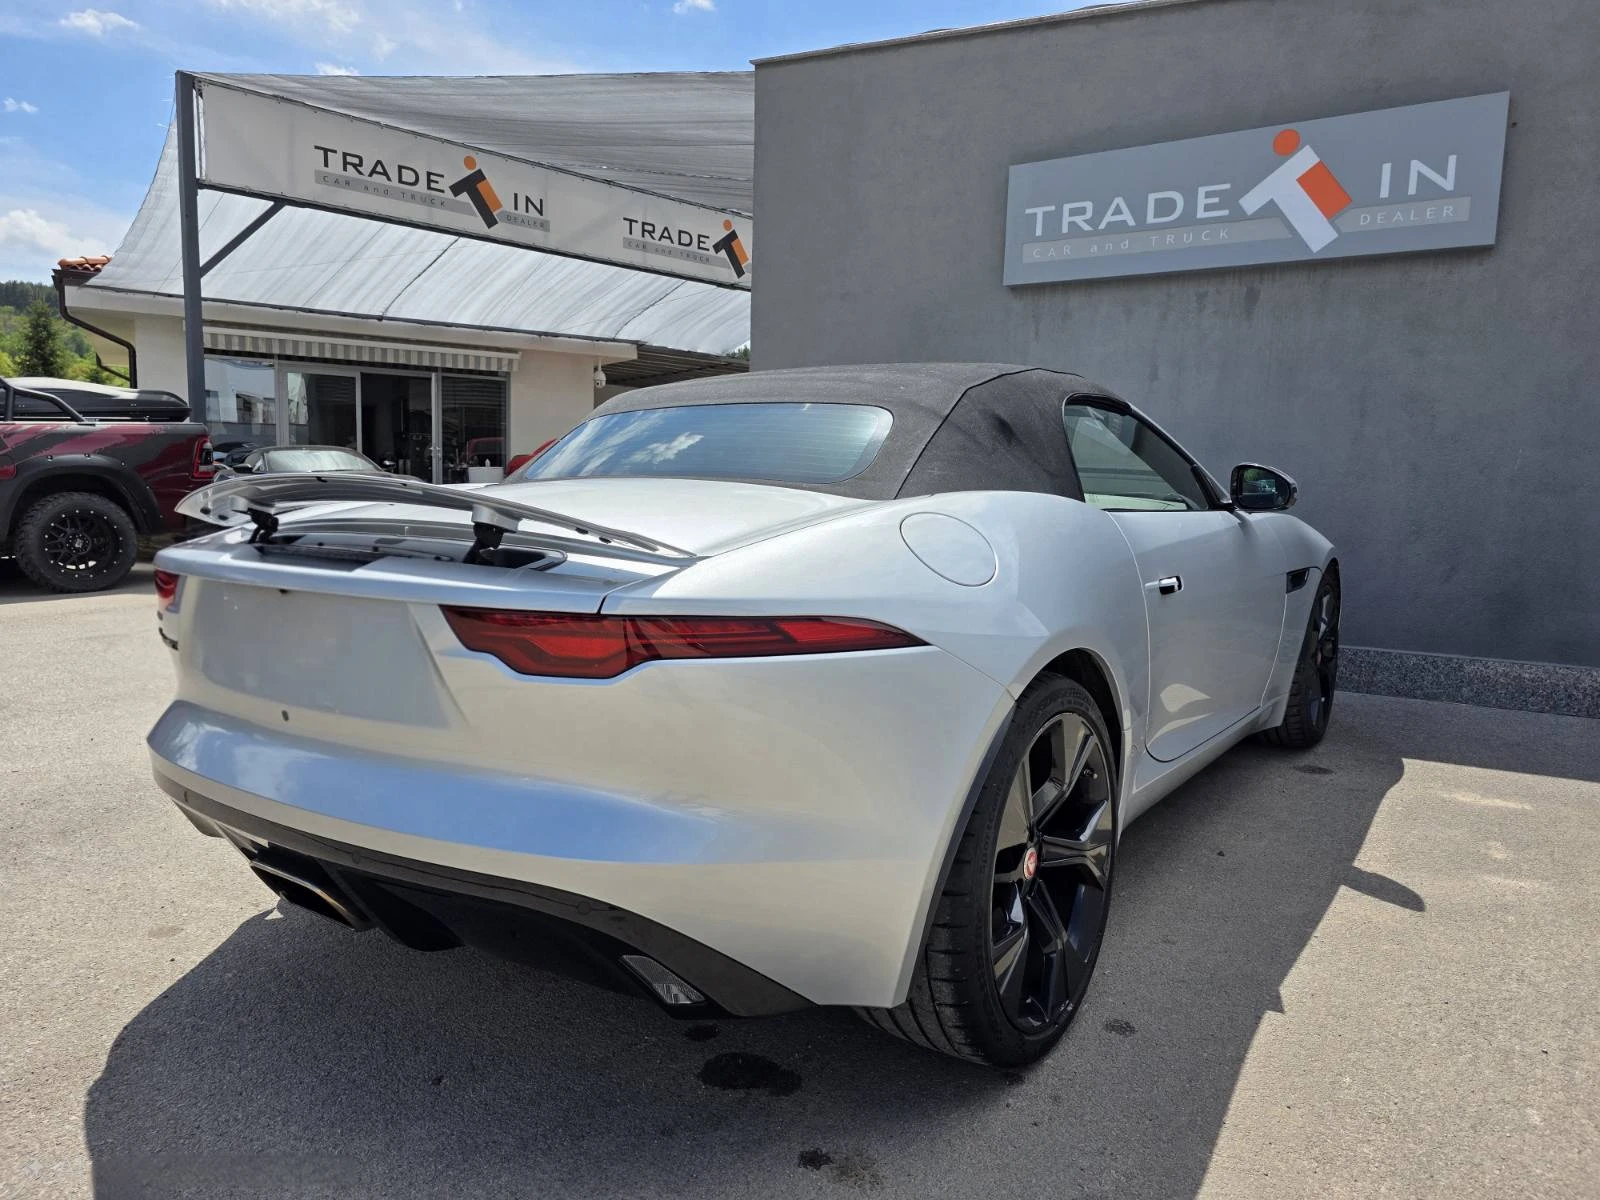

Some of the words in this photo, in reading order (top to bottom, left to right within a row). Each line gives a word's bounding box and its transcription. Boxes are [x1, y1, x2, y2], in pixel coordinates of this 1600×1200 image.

[314, 145, 445, 193] TRADE
[513, 192, 544, 217] IN
[322, 175, 350, 188] CAR
[401, 191, 447, 208] TRUCK
[506, 214, 546, 229] DEALER
[1024, 183, 1231, 237] TRADE
[1379, 154, 1457, 199] IN
[623, 217, 710, 251] TRADE
[1032, 245, 1071, 259] CAR
[1090, 239, 1129, 253] and
[1151, 228, 1230, 246] TRUCK
[1360, 205, 1455, 226] DEALER
